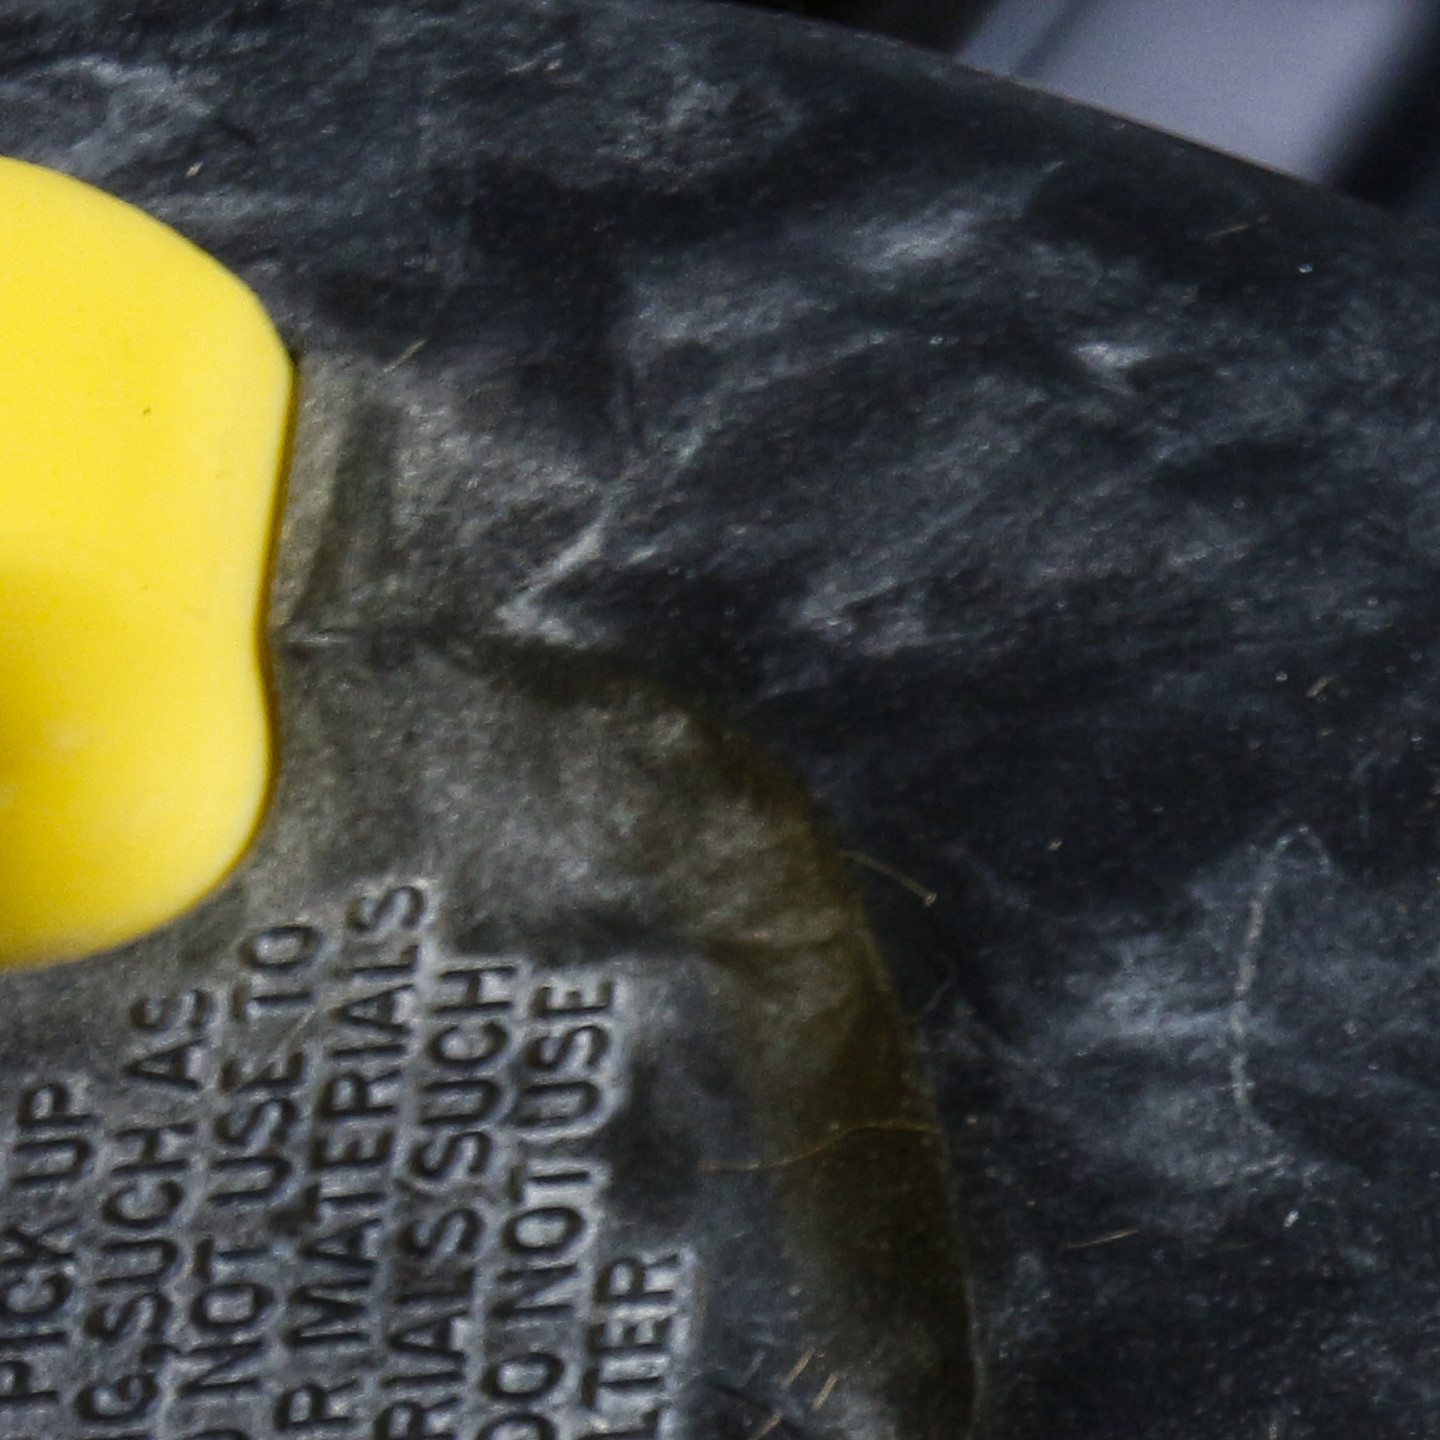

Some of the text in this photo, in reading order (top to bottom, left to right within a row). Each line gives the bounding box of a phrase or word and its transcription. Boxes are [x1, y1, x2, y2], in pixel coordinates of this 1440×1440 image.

[122, 988, 205, 1090] AS
[232, 925, 322, 1020] TO
[205, 1052, 307, 1208] USE
[283, 885, 427, 1348] MATERIALS
[410, 963, 515, 1182] SUCH
[515, 978, 615, 1133] USE
[12, 1082, 95, 1185] UP
[177, 1240, 272, 1392] NOT
[490, 1163, 592, 1320] NOT
